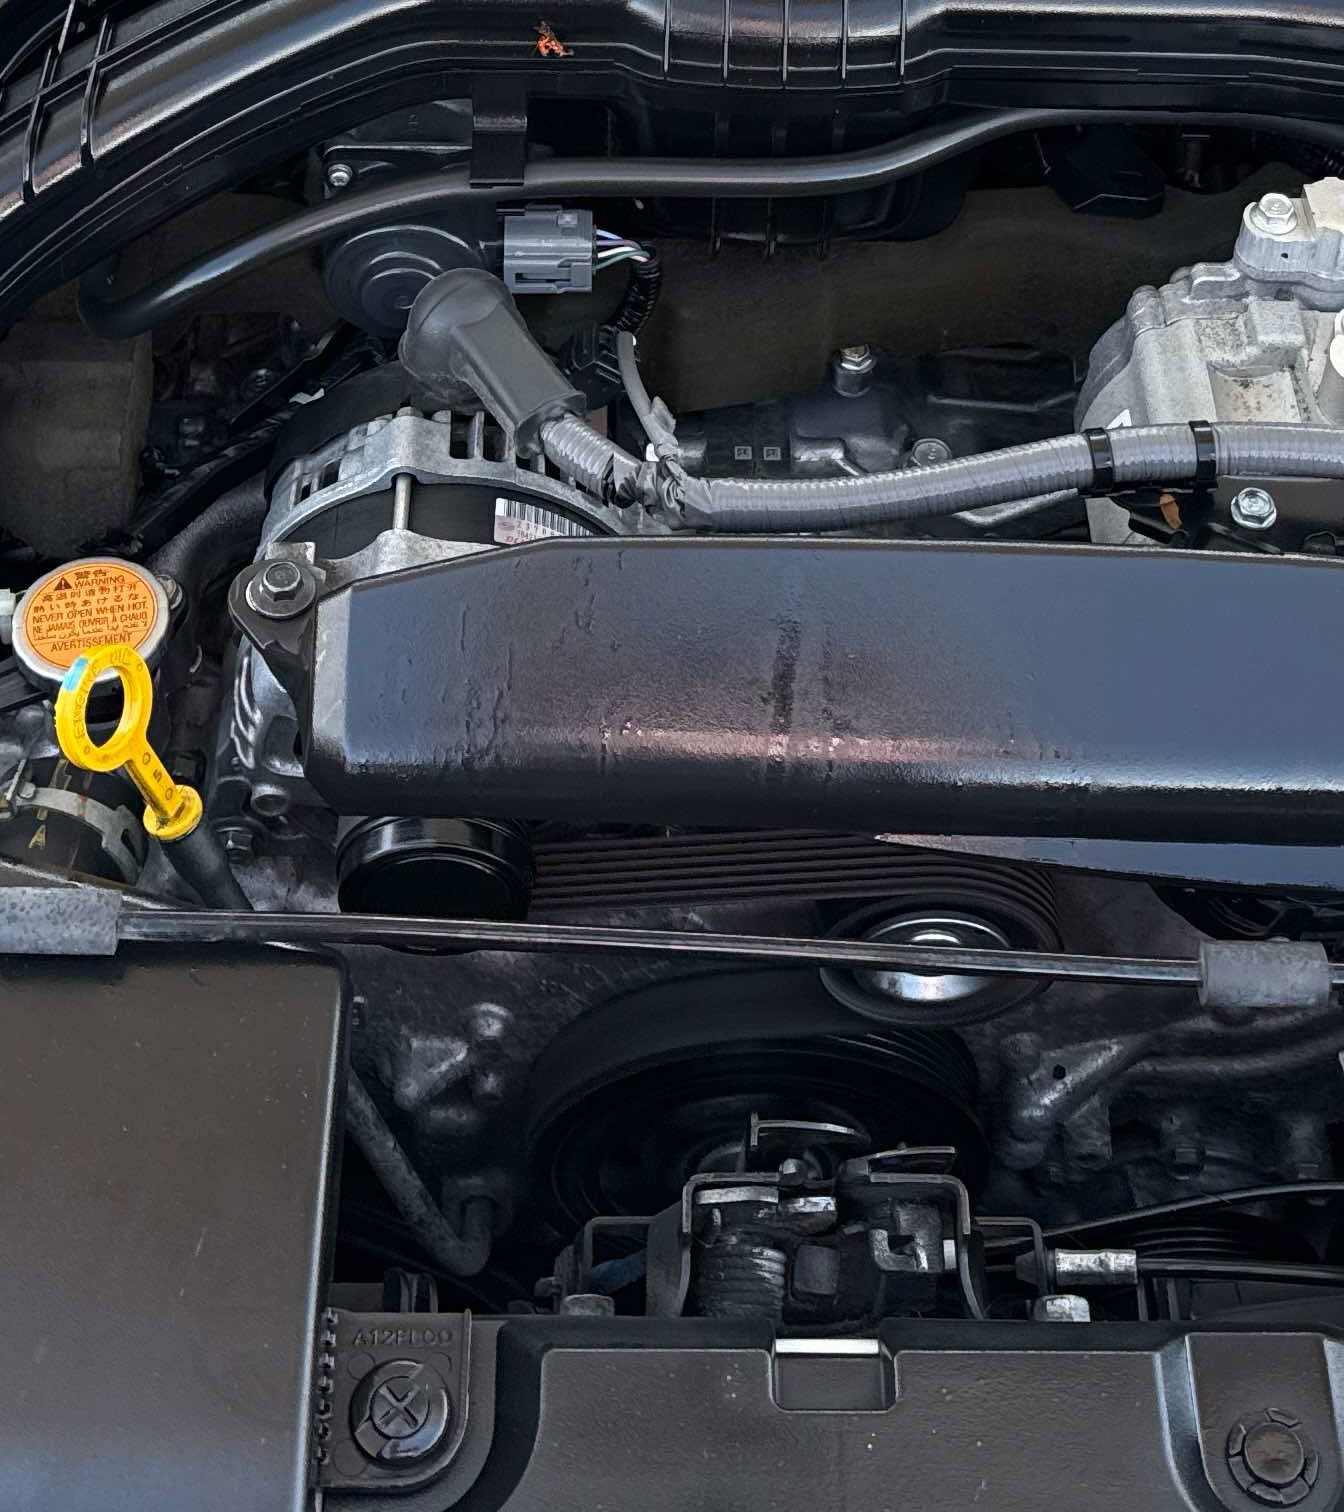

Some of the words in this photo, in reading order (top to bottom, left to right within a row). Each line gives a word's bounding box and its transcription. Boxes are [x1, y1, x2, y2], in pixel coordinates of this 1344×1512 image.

[74, 575, 125, 589] WARNING
[32, 612, 64, 625] NEVER
[66, 607, 93, 619] OPEN
[95, 603, 125, 616] WHEN
[32, 624, 45, 634] NE
[46, 620, 77, 633] JAMAIS
[78, 616, 109, 629] OUVRIR
[50, 631, 133, 653] AVERTISSEMENT
